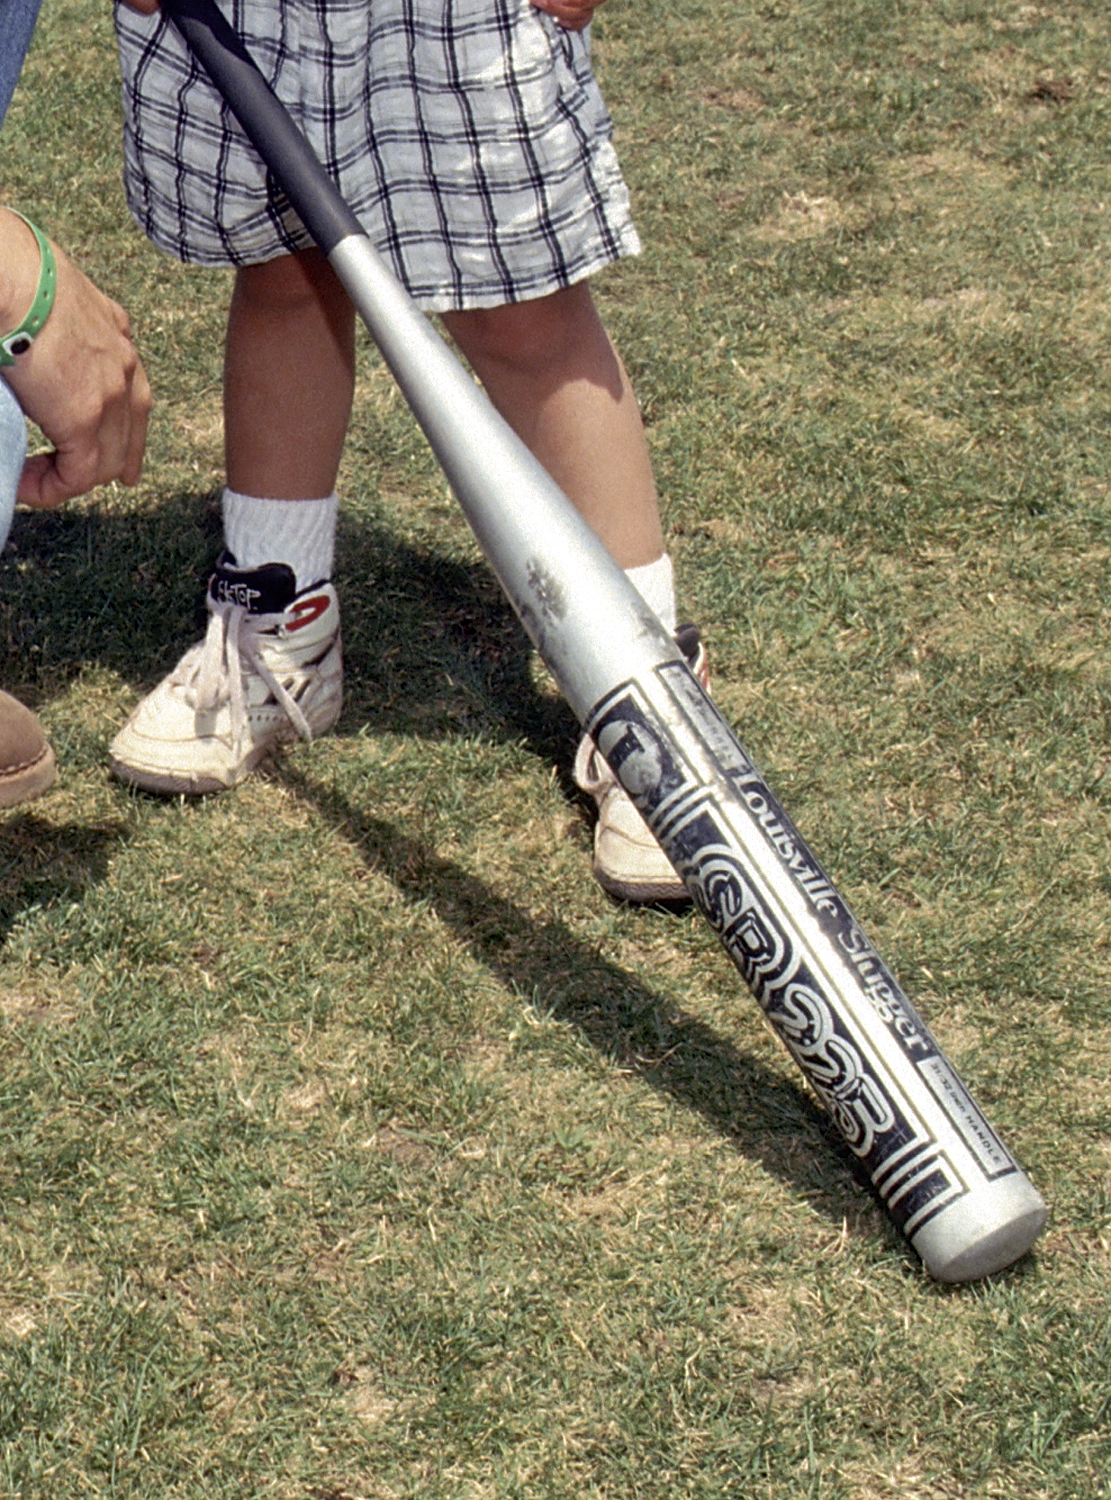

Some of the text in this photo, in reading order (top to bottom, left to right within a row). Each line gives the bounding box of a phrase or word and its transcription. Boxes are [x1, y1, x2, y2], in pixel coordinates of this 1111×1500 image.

[731, 777, 929, 1049] Louisville Slugger
[965, 1115, 1001, 1163] HANDLE
